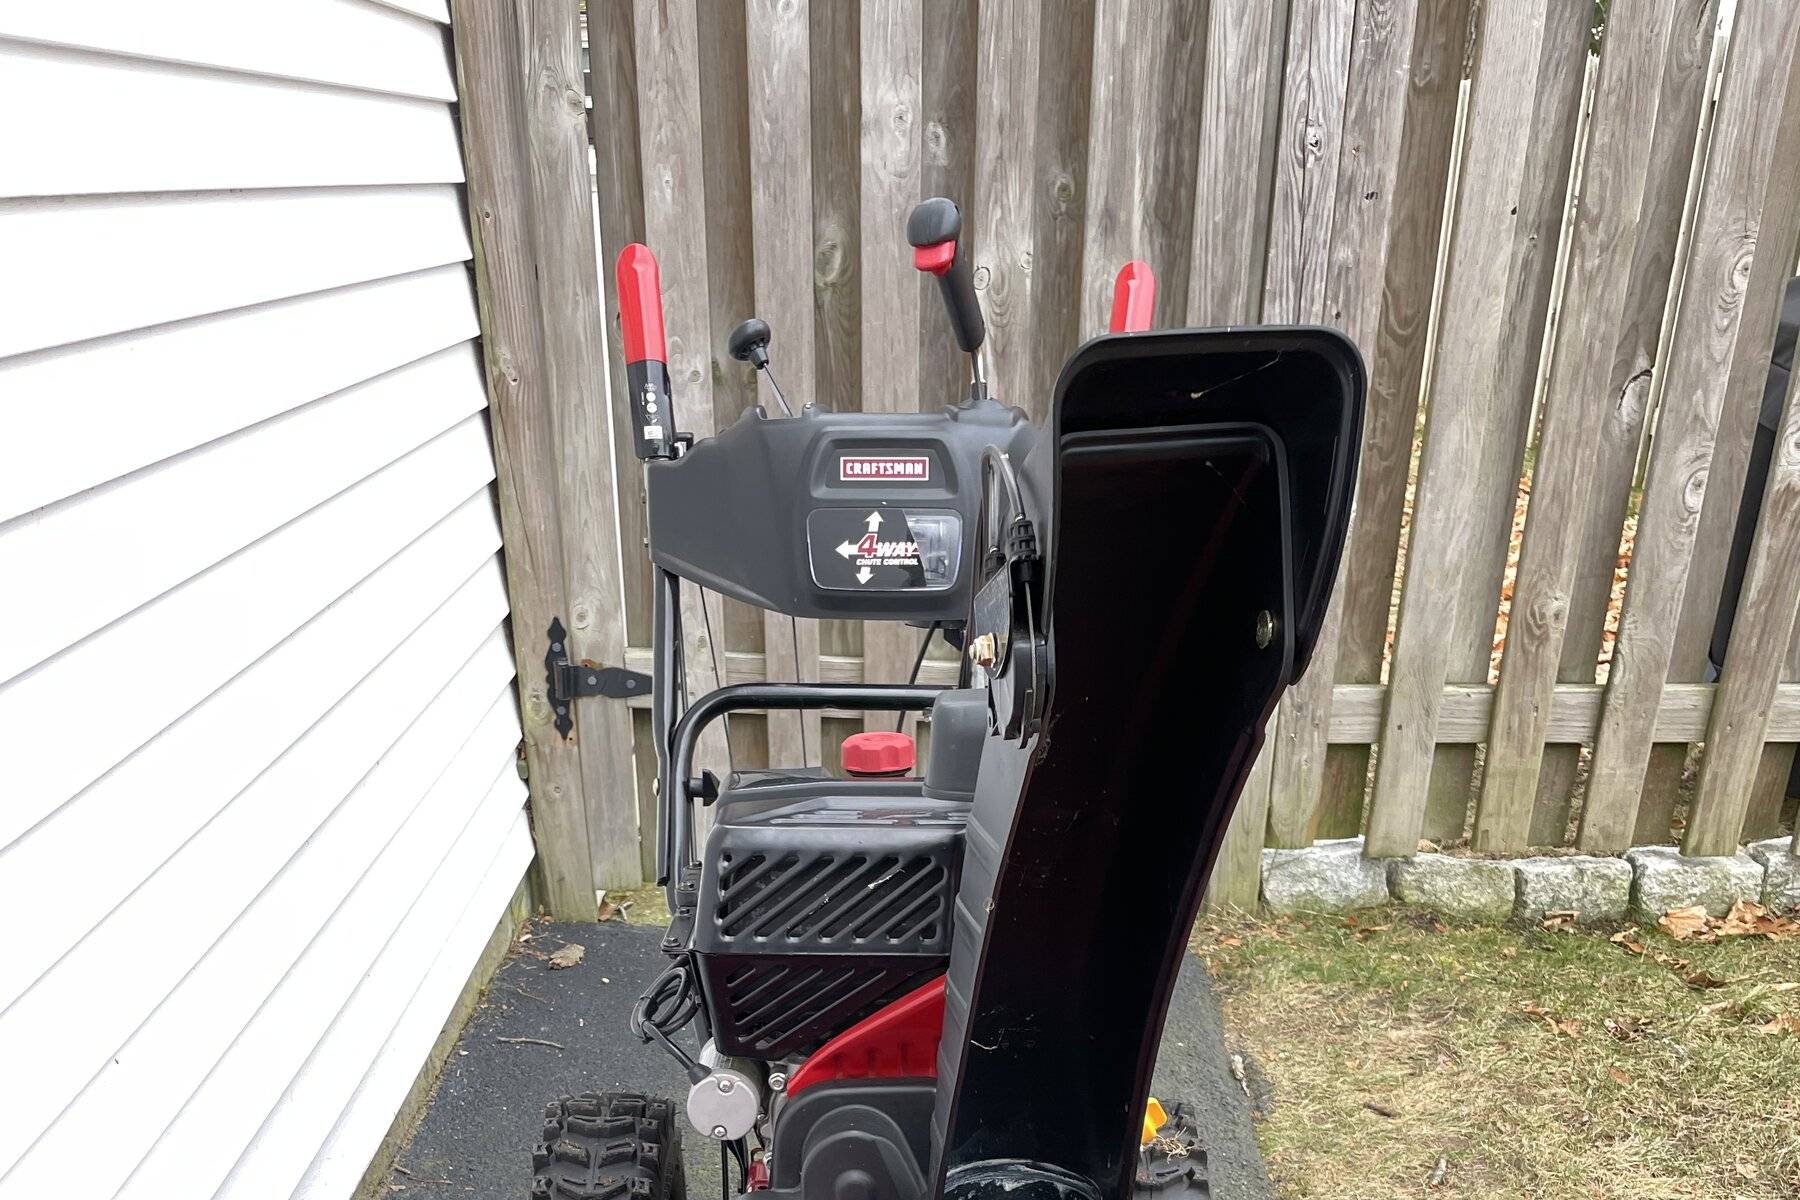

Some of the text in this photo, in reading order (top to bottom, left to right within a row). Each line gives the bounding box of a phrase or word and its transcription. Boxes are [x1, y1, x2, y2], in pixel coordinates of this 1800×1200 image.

[845, 462, 923, 475] CRAFTSMAN
[856, 558, 919, 566] CHUTE CONTROL
